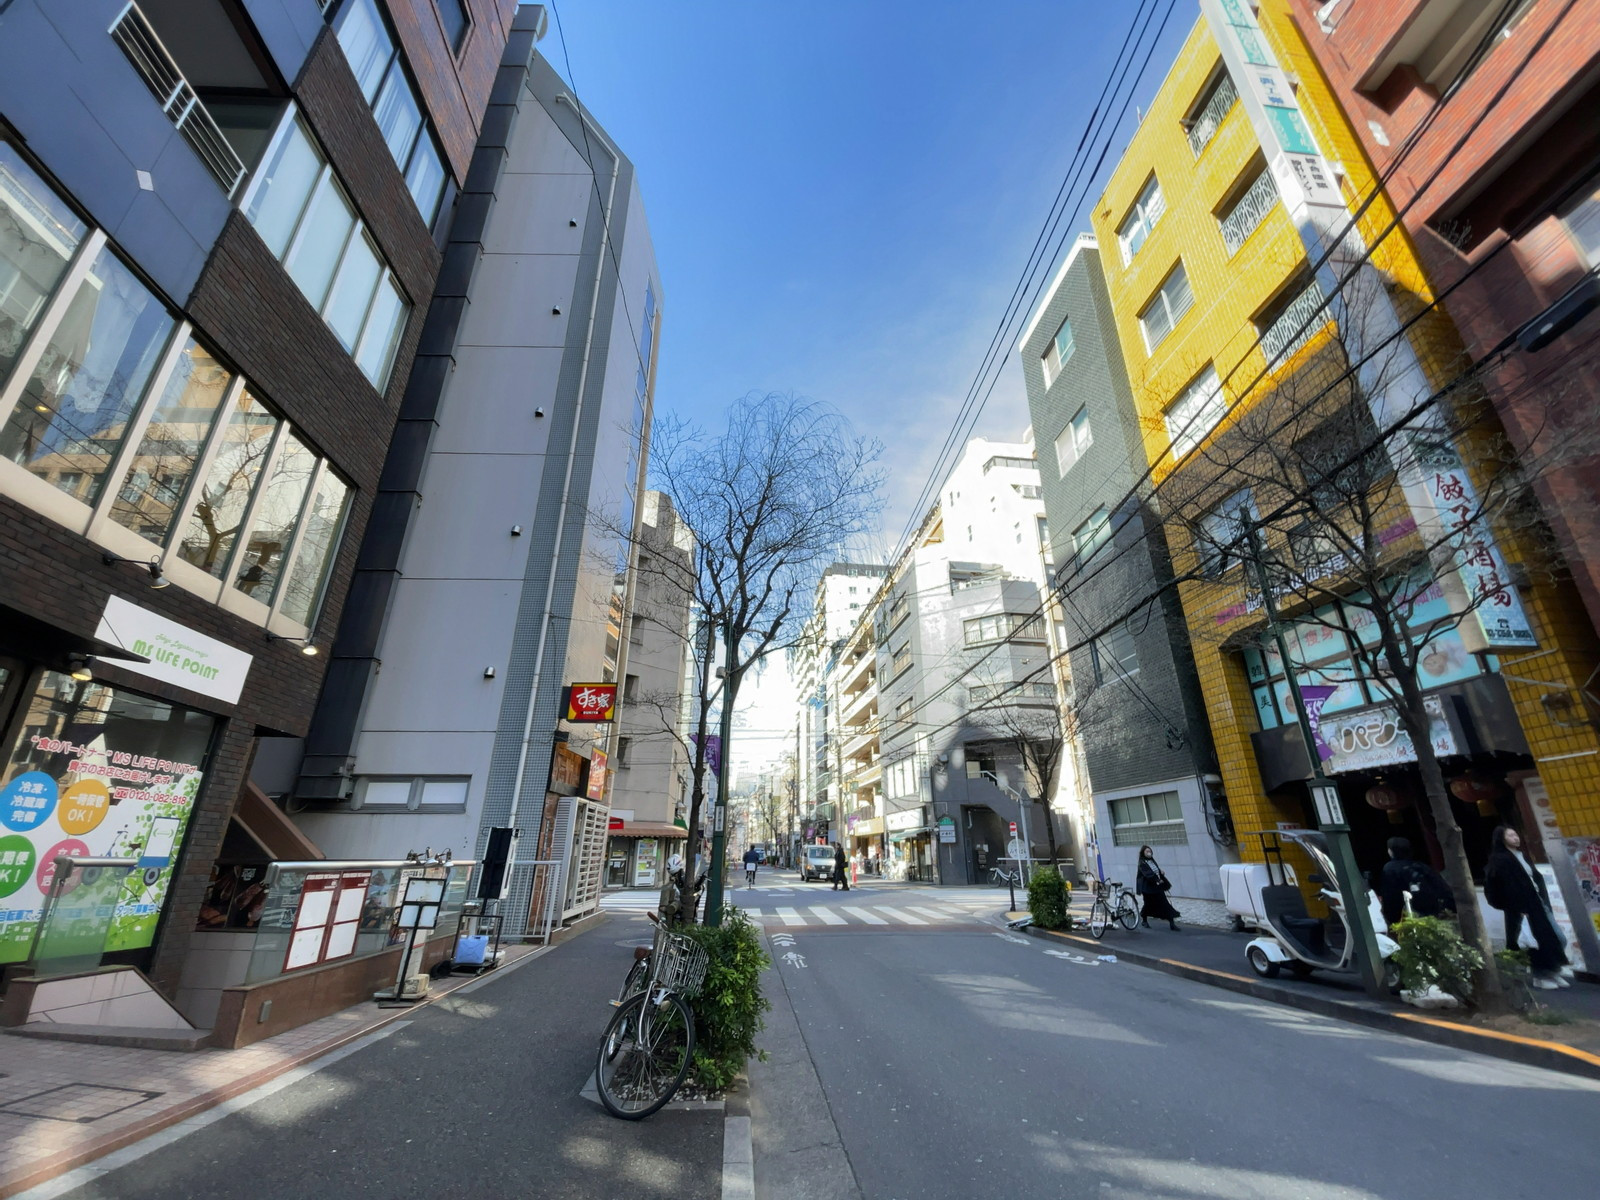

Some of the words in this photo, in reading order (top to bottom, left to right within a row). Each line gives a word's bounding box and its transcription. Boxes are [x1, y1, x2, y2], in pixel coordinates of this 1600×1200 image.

[1435, 473, 1512, 607] 餃子酒場
[132, 640, 154, 656] MS
[155, 648, 180, 667] LIFE
[181, 658, 219, 680] POINT
[576, 687, 610, 710] すき家
[131, 755, 157, 769] LIFE
